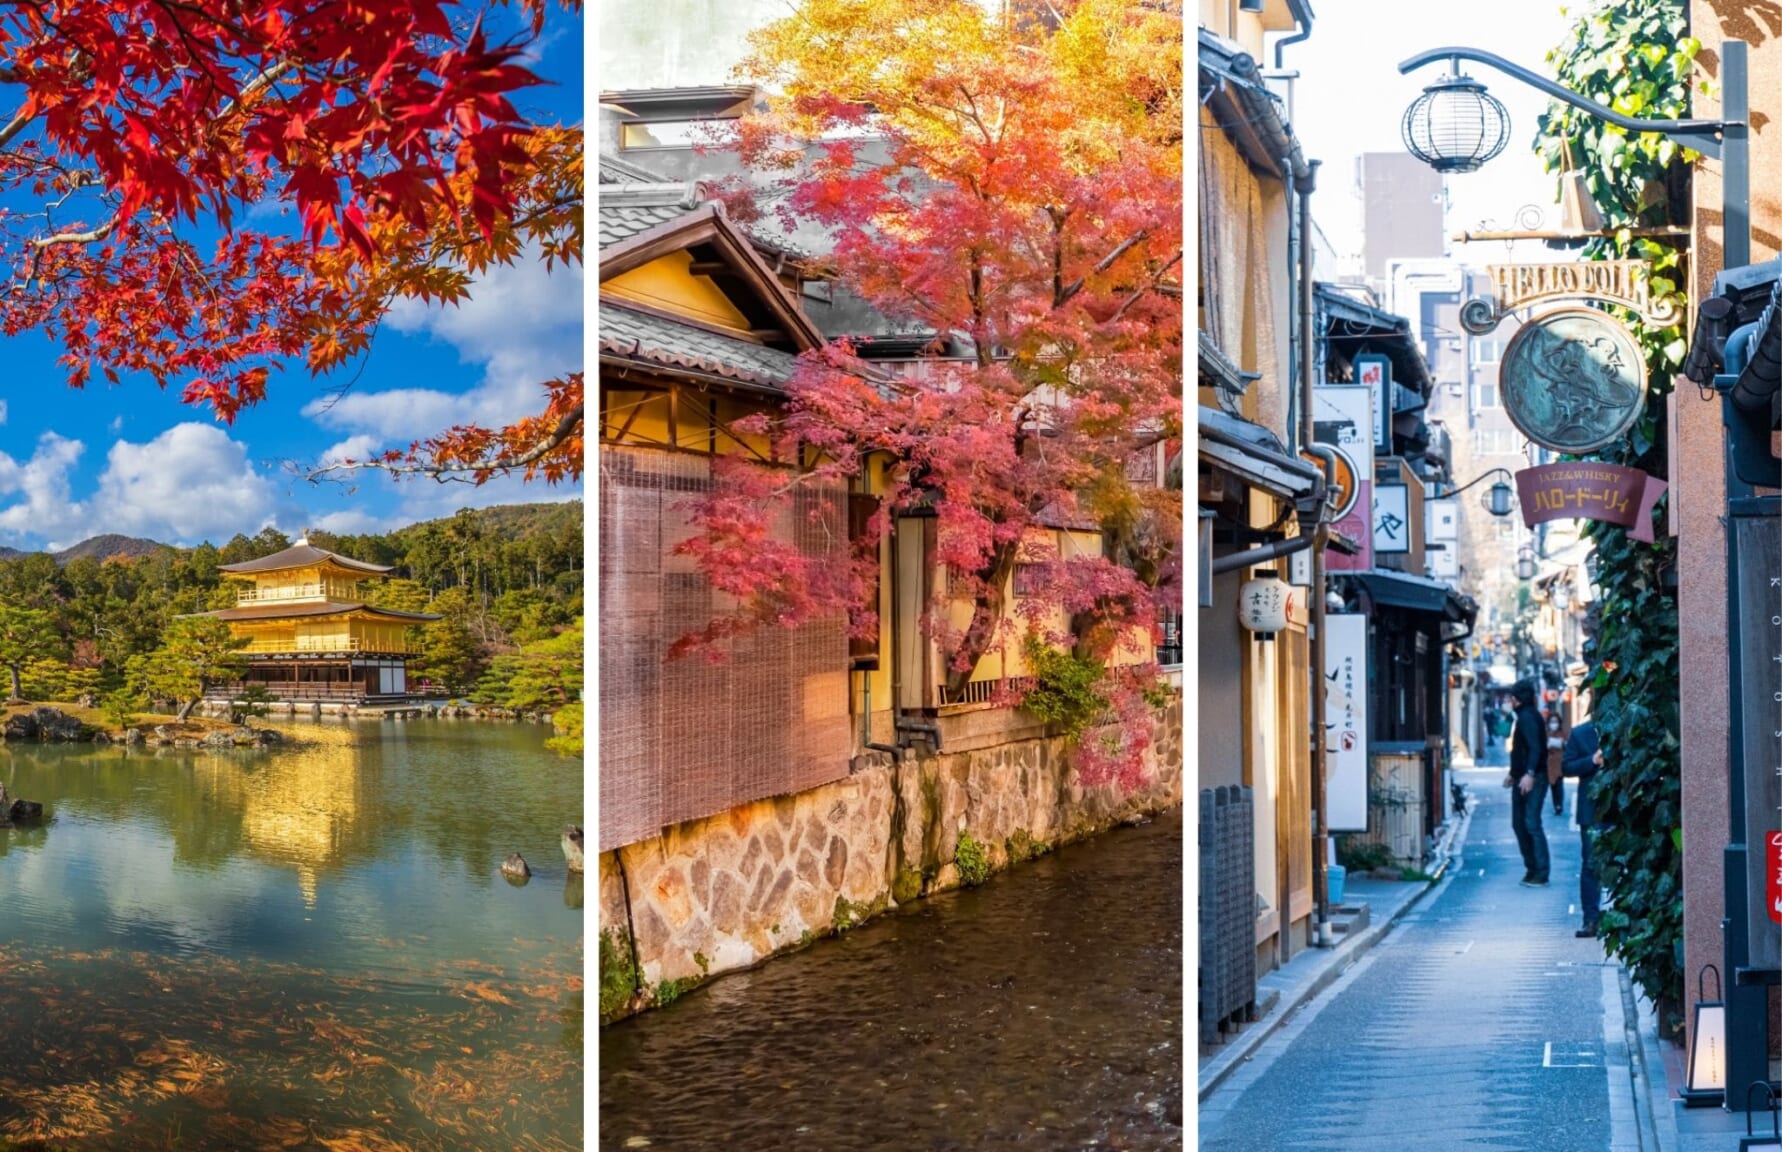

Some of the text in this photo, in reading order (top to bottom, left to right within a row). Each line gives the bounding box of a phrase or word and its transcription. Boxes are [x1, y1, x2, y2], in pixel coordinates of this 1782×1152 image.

[1494, 264, 1578, 312] HELLO
[1539, 470, 1620, 484] JAZZ&WHISKY
[1534, 487, 1629, 513] ハロードーリィ
